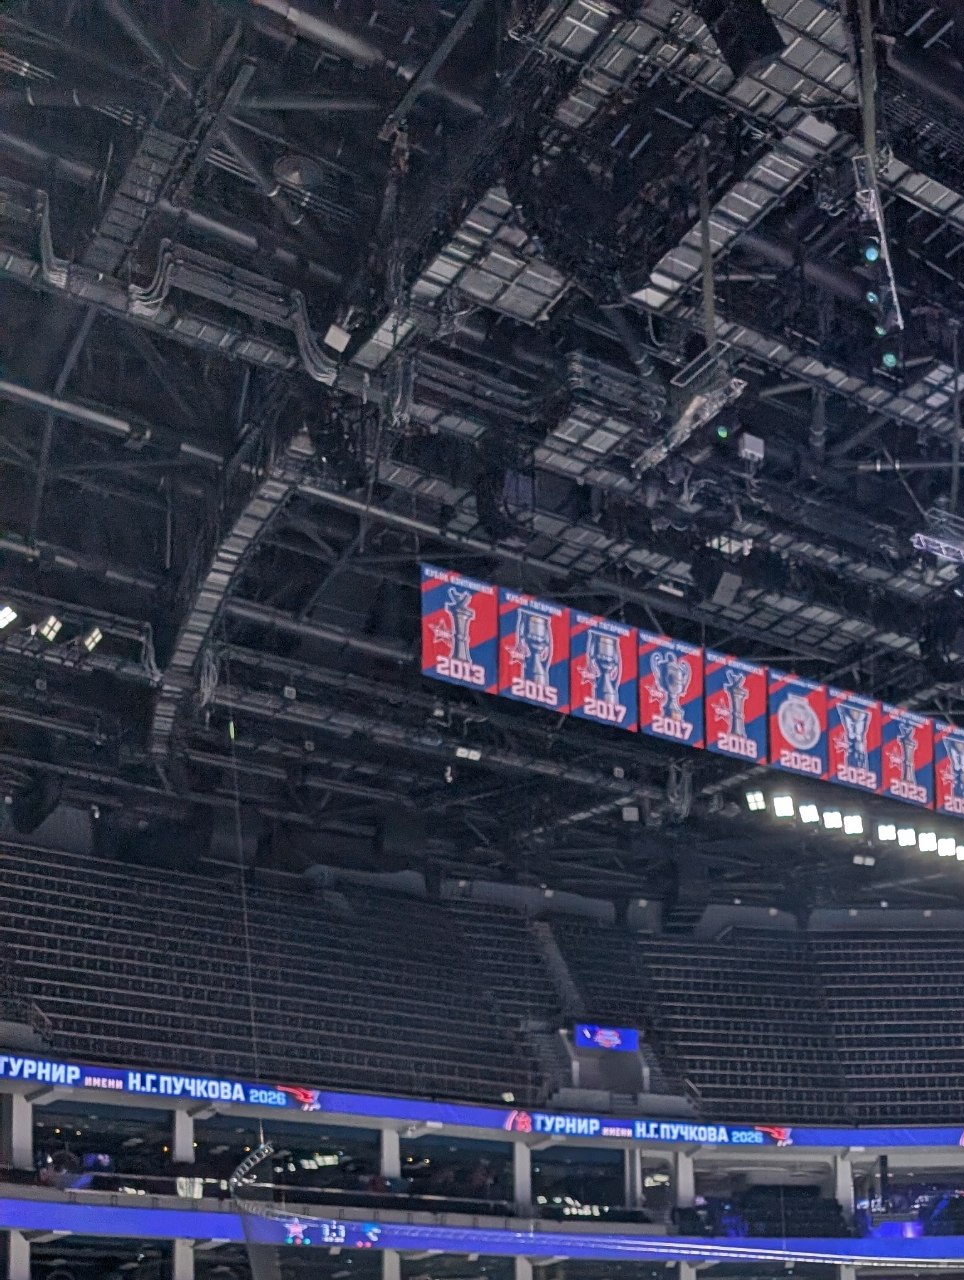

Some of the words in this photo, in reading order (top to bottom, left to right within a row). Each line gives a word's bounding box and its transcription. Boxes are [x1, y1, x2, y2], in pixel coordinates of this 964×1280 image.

[436, 655, 485, 685] 2013
[511, 677, 558, 706] 2015
[583, 697, 627, 723] 2017
[652, 715, 693, 740] 2017
[717, 732, 758, 758] 2018
[780, 750, 822, 774] 2020
[837, 764, 877, 789] 2022
[890, 779, 927, 803] 2023
[84, 1076, 123, 1090] ИМЕНИ
[249, 1089, 287, 1105] 2026
[534, 1116, 600, 1135] ТУРНИР
[731, 1131, 763, 1144] 2026
